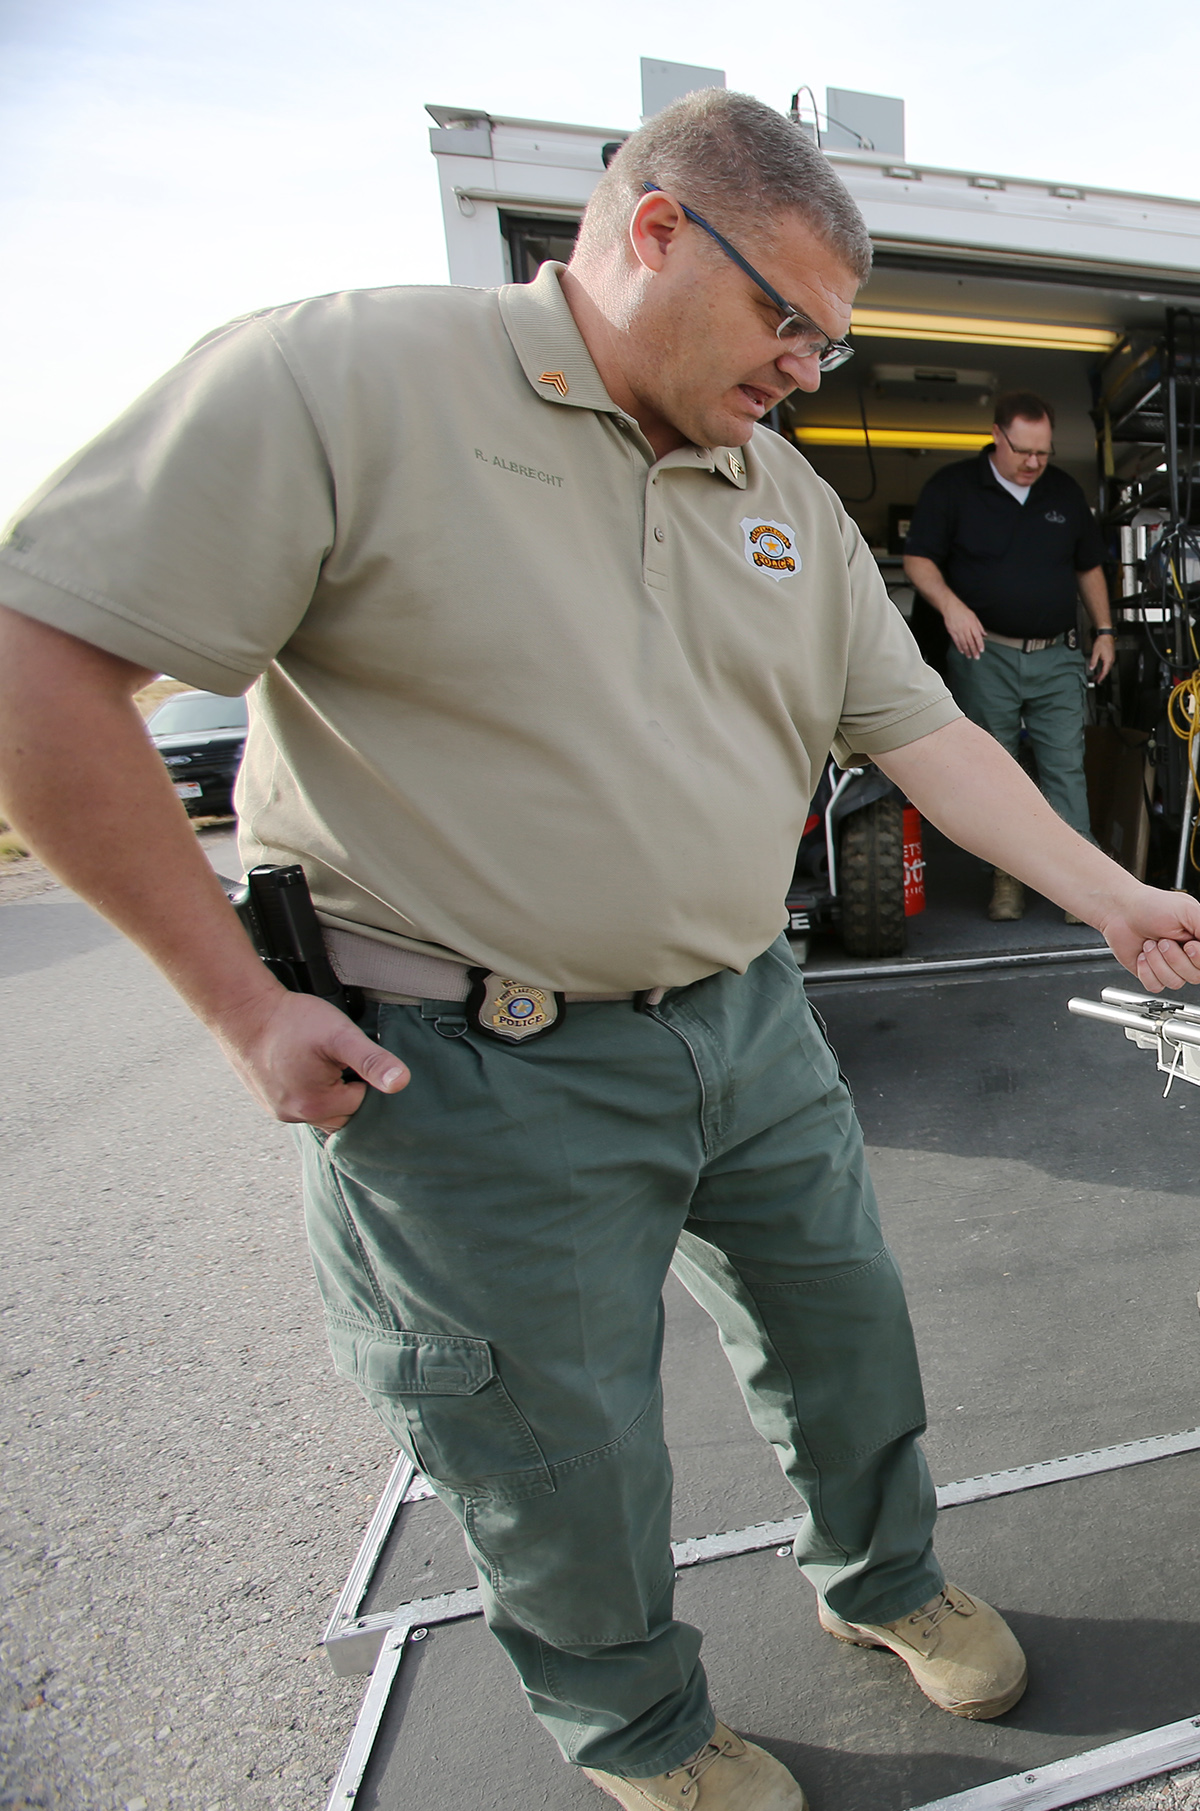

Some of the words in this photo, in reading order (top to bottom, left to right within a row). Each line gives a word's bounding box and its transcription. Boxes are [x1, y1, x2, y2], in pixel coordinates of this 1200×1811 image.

[474, 448, 488, 462] R.
[493, 456, 564, 488] ALBRECHT
[499, 1014, 543, 1027] POLICE
